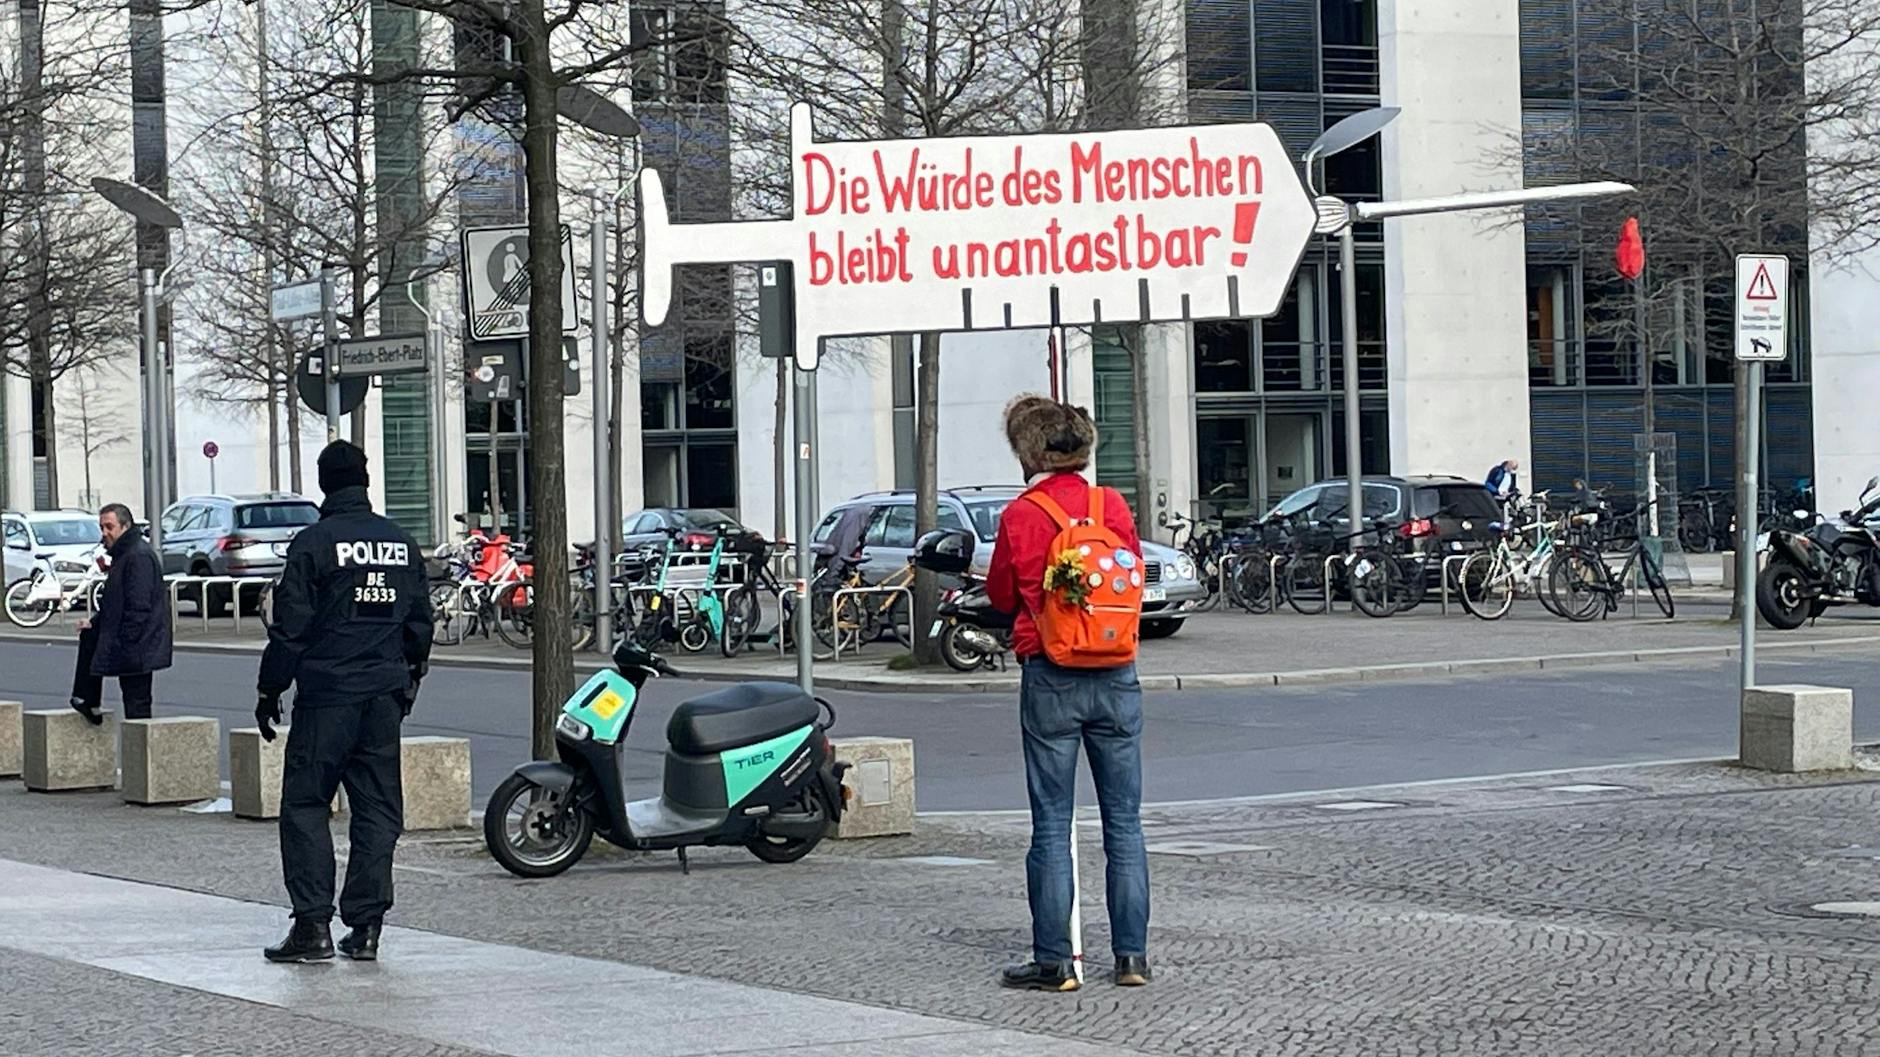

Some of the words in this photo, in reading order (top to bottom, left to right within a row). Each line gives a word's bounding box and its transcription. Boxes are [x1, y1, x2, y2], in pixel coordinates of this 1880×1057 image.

[802, 153, 869, 215] Die
[873, 147, 993, 212] Würde
[1003, 146, 1062, 205] des
[1071, 137, 1263, 203] Menschen
[810, 228, 913, 285] bleibt
[336, 541, 409, 567] POLIZEI
[366, 571, 386, 587] BE
[354, 586, 397, 603] 36333
[734, 750, 775, 769] TIER
